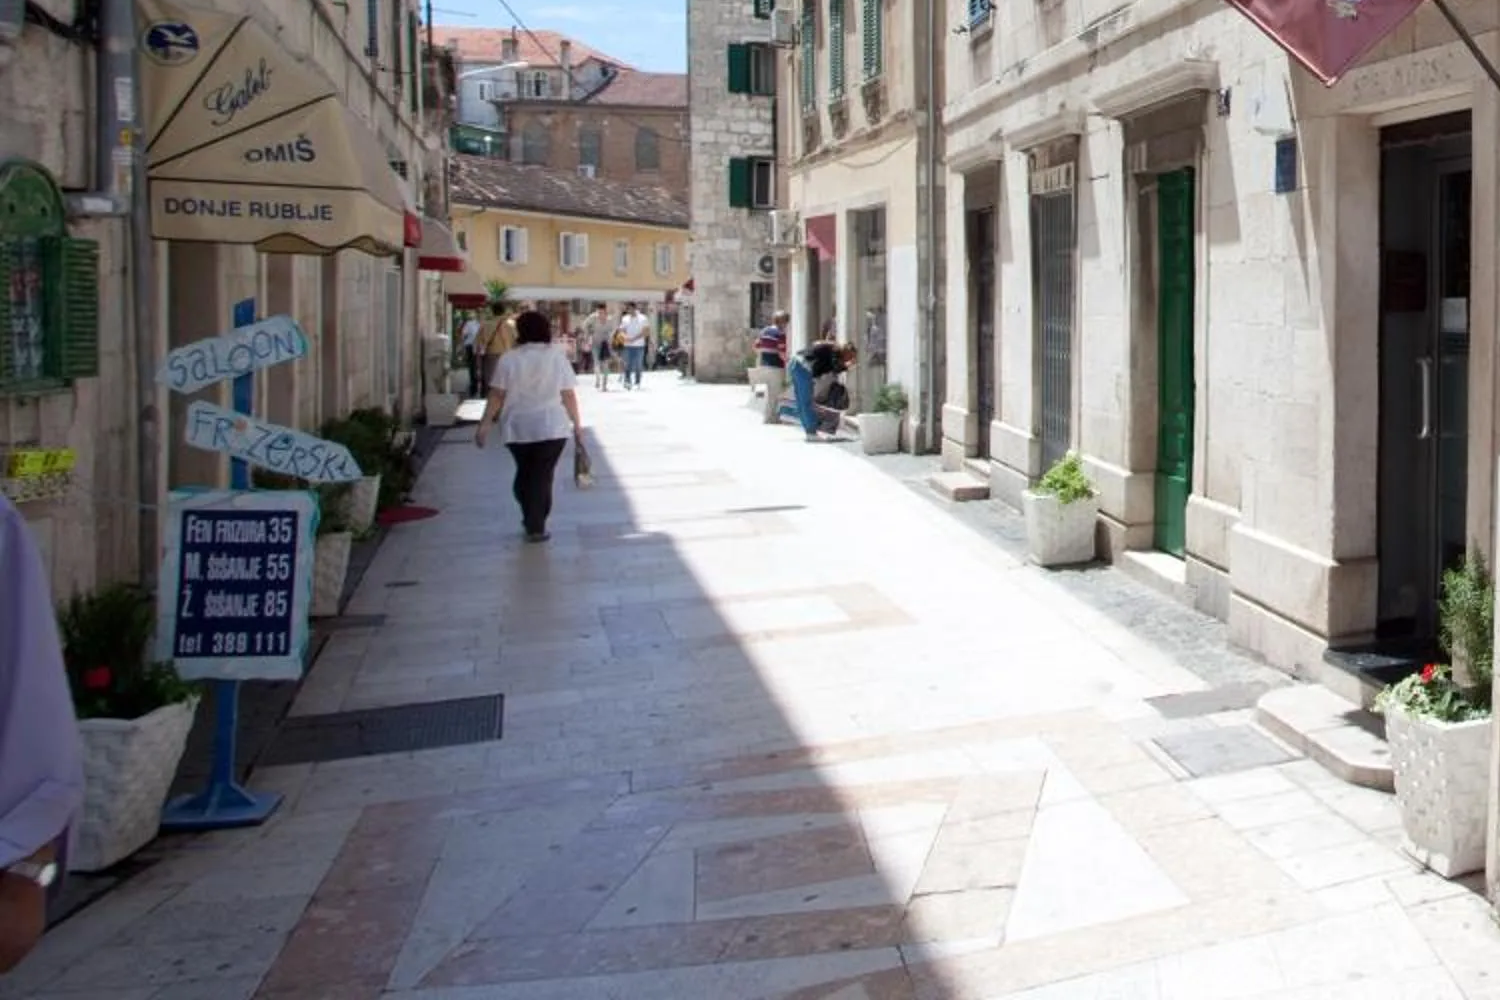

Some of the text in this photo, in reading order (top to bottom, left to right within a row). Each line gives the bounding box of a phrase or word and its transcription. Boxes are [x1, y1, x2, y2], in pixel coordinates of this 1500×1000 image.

[245, 134, 316, 164] OMIŠ
[164, 198, 333, 221] DONJE RUBLJE
[267, 517, 292, 544] 35
[265, 553, 289, 581] 55
[263, 590, 288, 617] 85
[255, 631, 287, 654] 111
